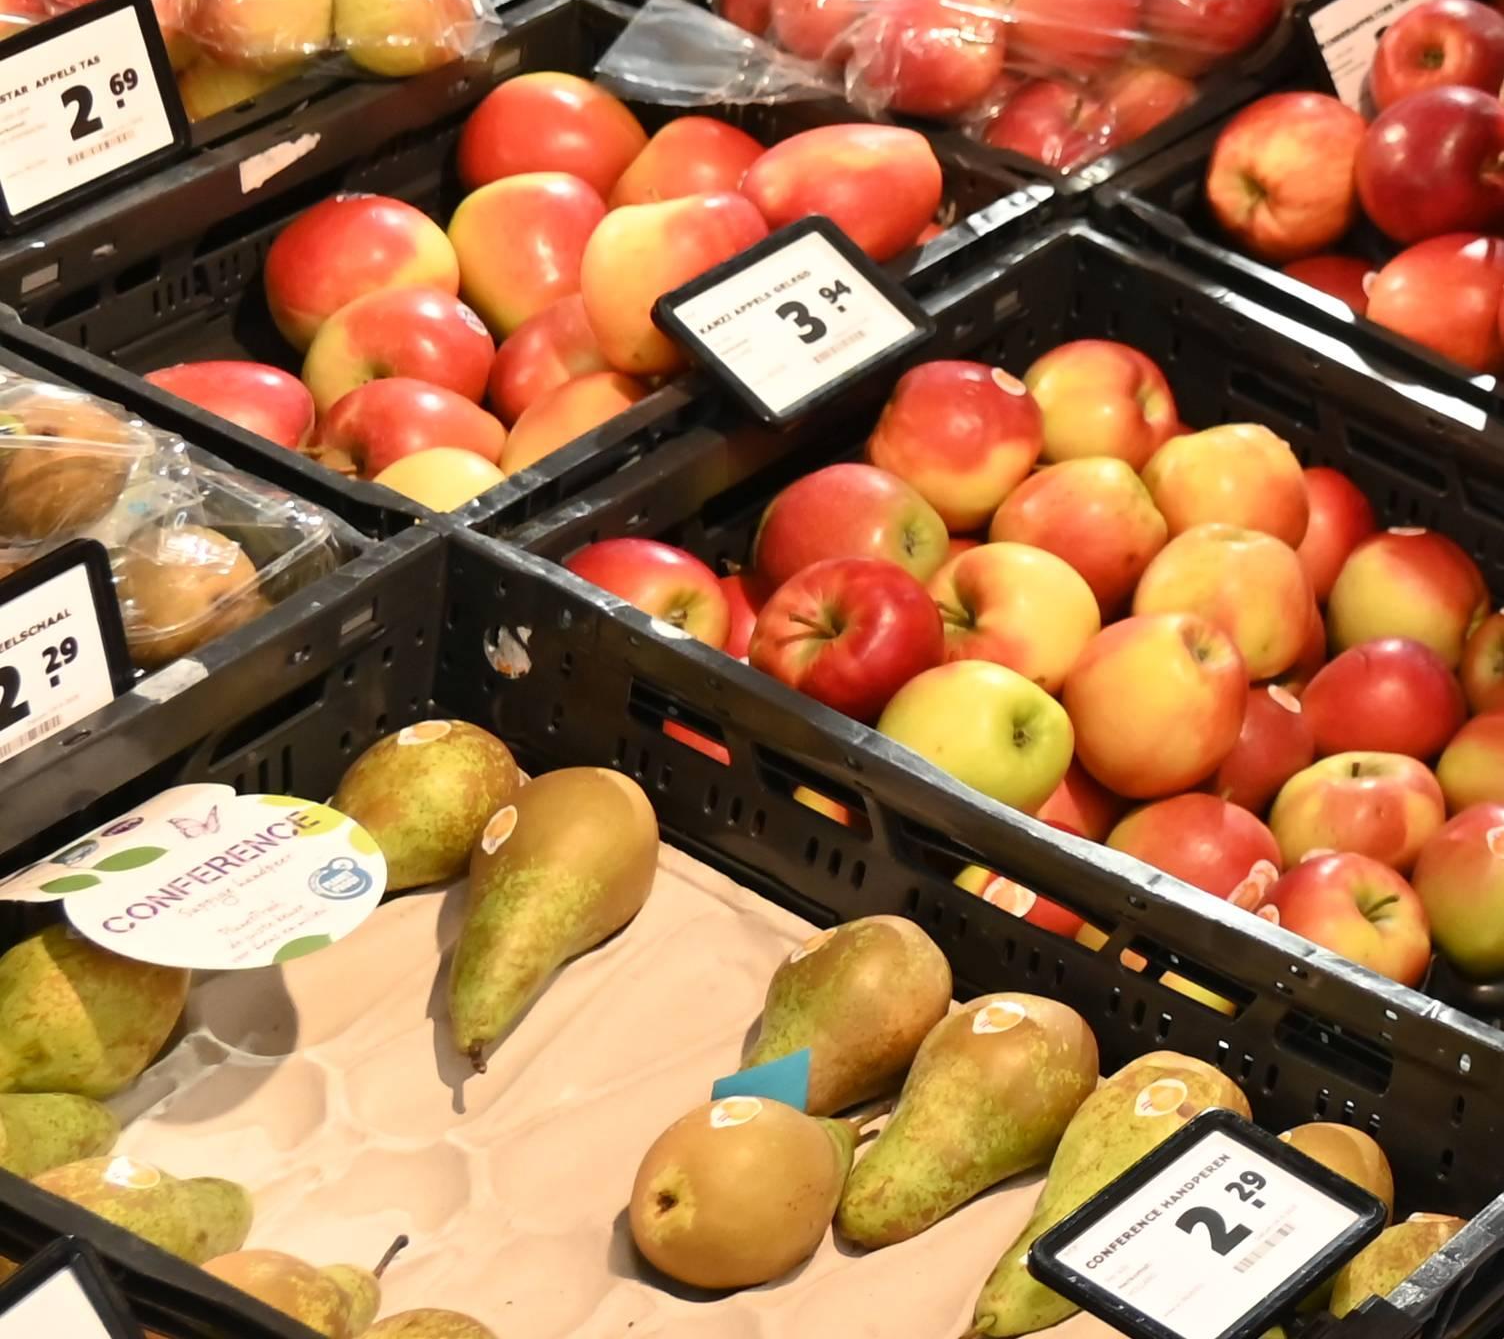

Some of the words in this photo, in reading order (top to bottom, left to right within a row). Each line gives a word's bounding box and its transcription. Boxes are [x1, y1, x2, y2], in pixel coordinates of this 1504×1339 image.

[35, 64, 77, 90] APPELS
[80, 54, 101, 71] TAS
[698, 311, 732, 336] KANZI
[734, 290, 772, 316] APPELS
[102, 810, 322, 935] CONFERENCE
[1085, 1205, 1163, 1271] CONFERENCE
[1160, 1152, 1232, 1210] HANDPEREN
